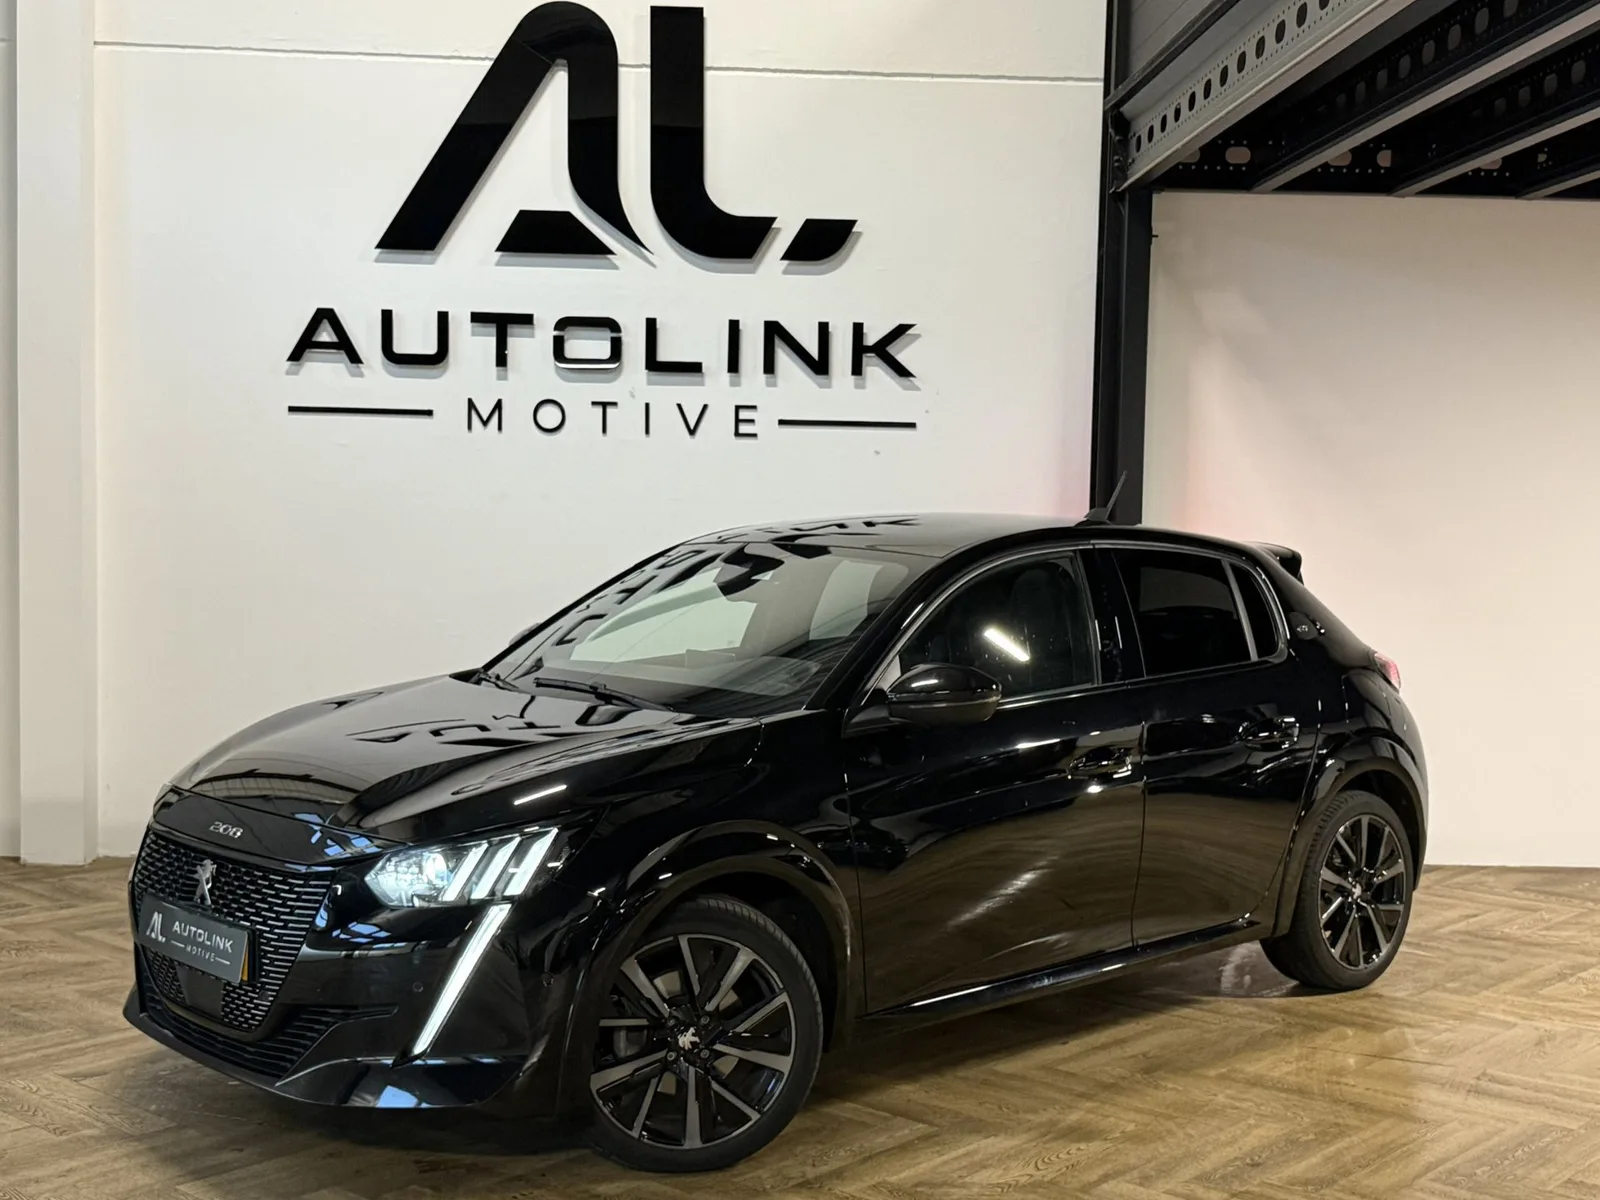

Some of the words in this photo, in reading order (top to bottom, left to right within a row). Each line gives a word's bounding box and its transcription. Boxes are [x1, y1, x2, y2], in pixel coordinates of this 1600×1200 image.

[286, 307, 918, 379] AUTOLINK
[467, 397, 759, 438] MOTIVE
[209, 820, 244, 839] 208
[172, 921, 234, 954] AUTOLINK
[186, 944, 216, 962] MOTIVE
